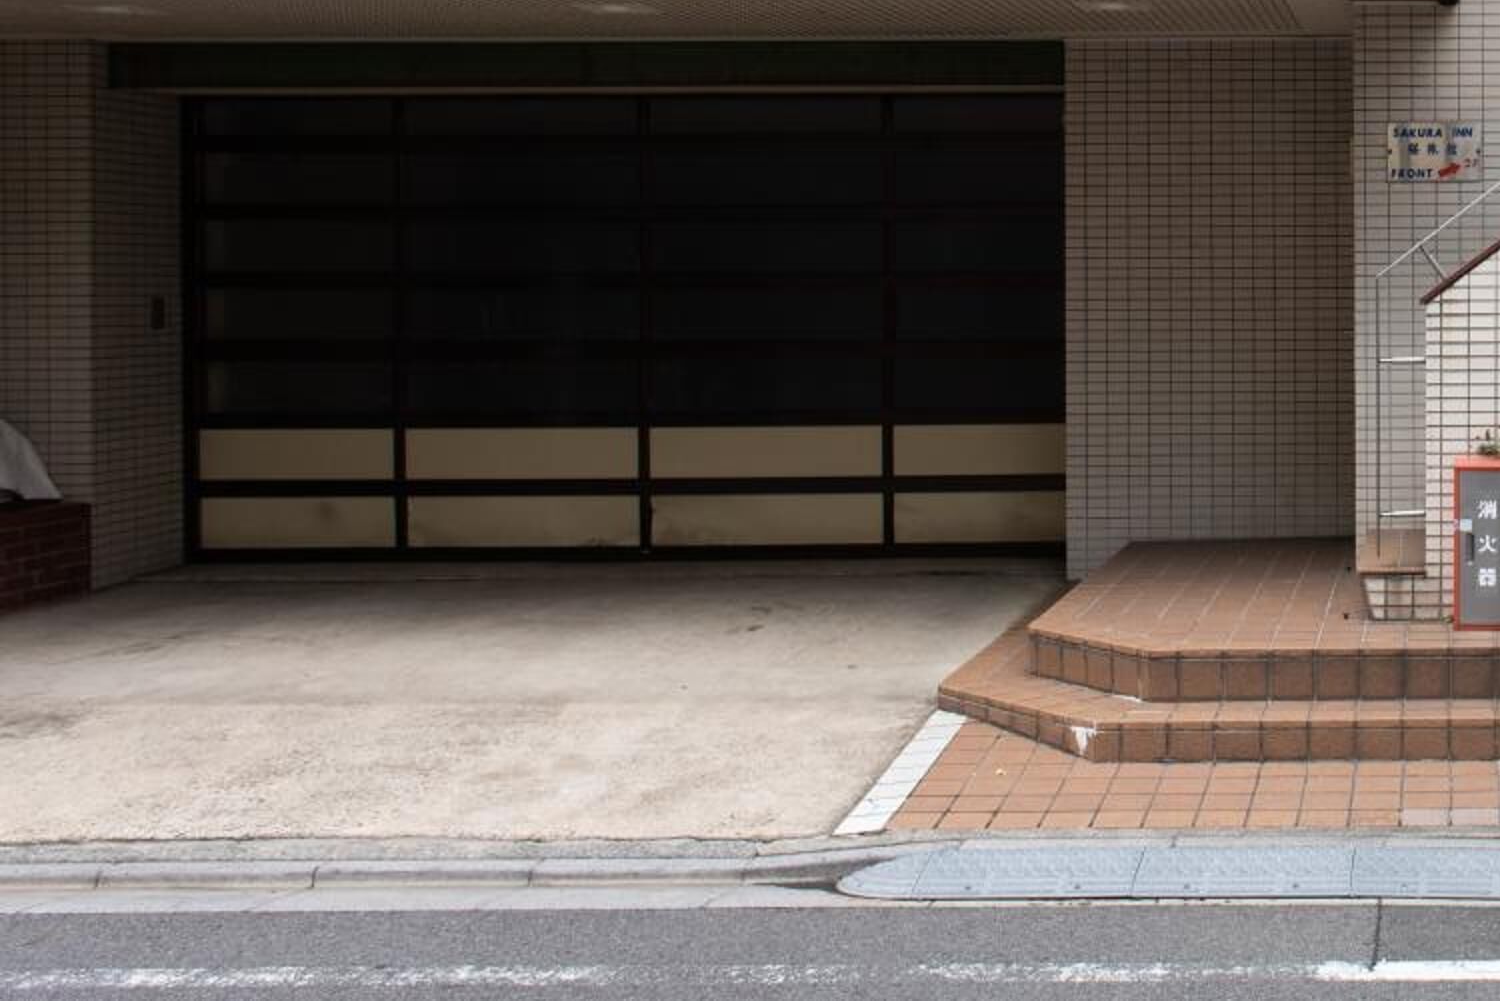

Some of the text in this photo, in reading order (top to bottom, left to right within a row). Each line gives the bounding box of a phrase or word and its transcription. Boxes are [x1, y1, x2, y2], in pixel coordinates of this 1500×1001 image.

[1393, 126, 1473, 138] SAKURA INN
[1391, 167, 1432, 178] FRONT
[1477, 499, 1498, 587] 消火器
